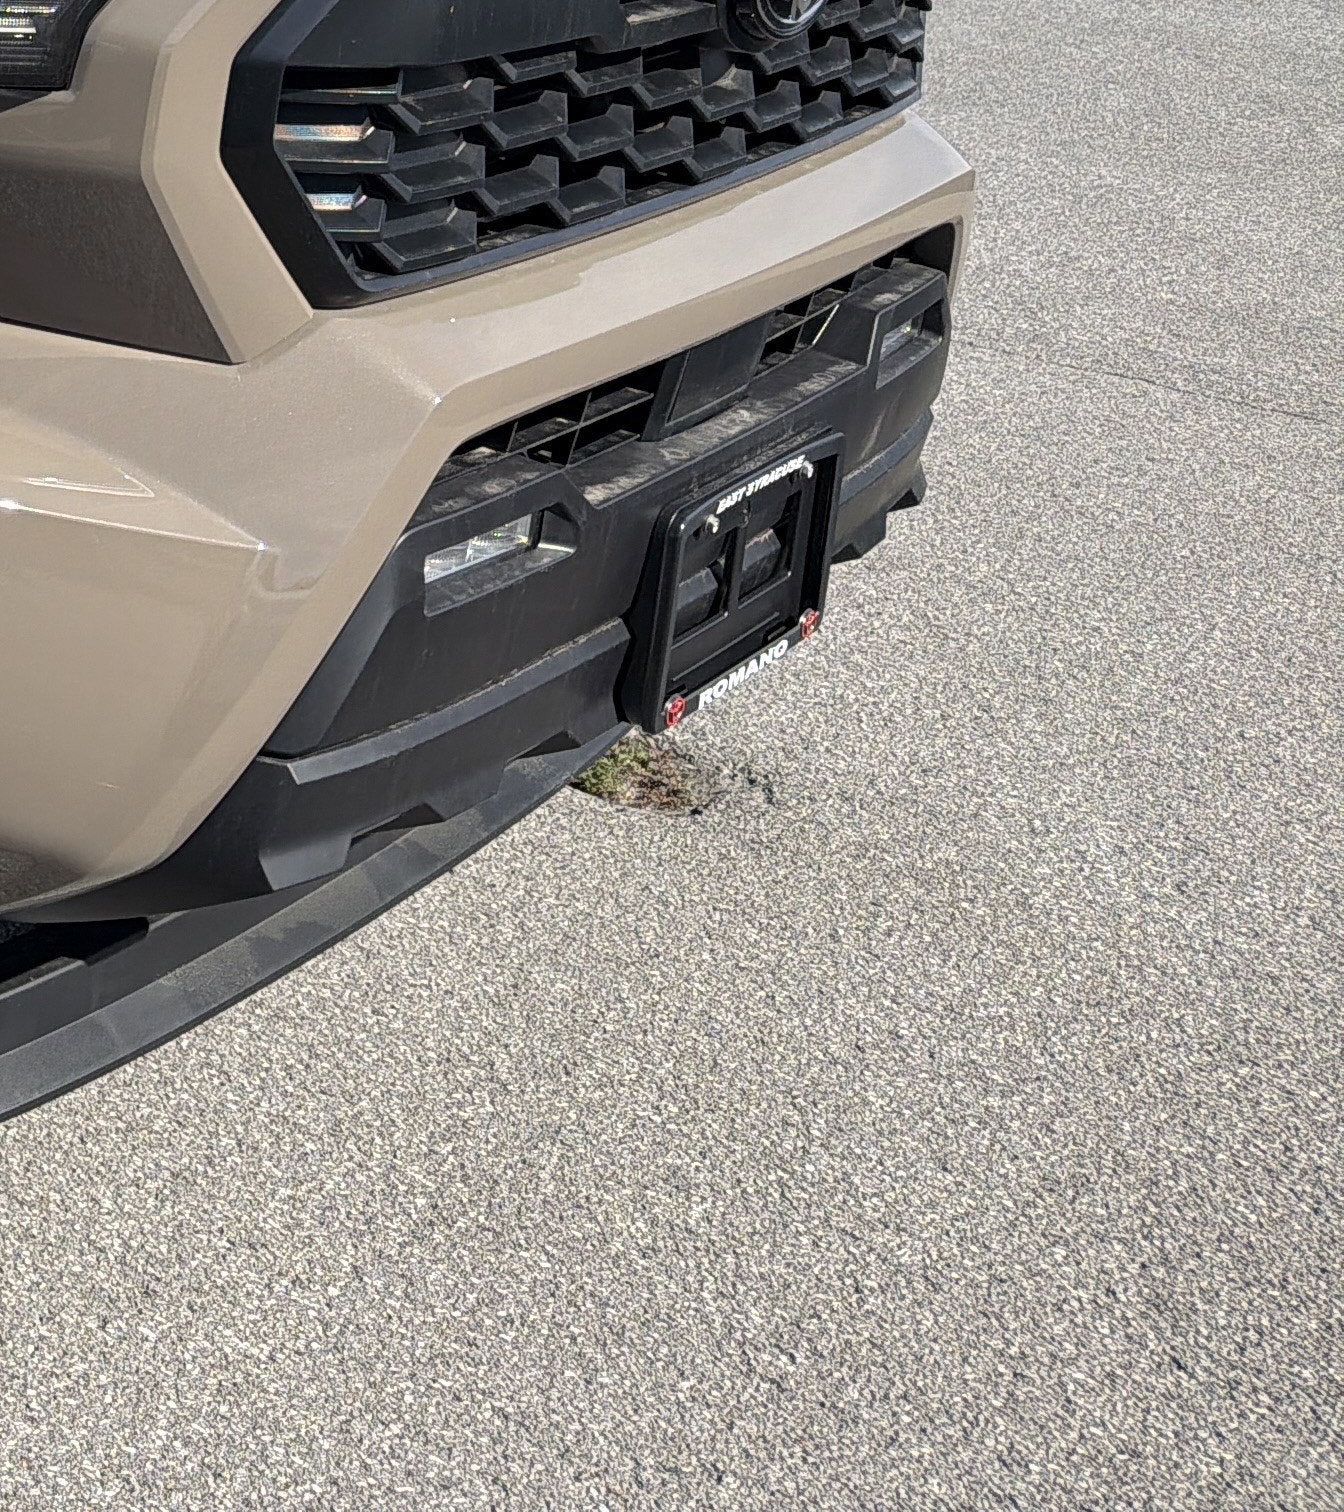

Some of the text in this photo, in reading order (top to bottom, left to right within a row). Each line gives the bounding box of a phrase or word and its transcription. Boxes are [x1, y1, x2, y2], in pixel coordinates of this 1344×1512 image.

[716, 454, 806, 515] EAST SYRACUSE
[698, 639, 790, 710] ROMANO
